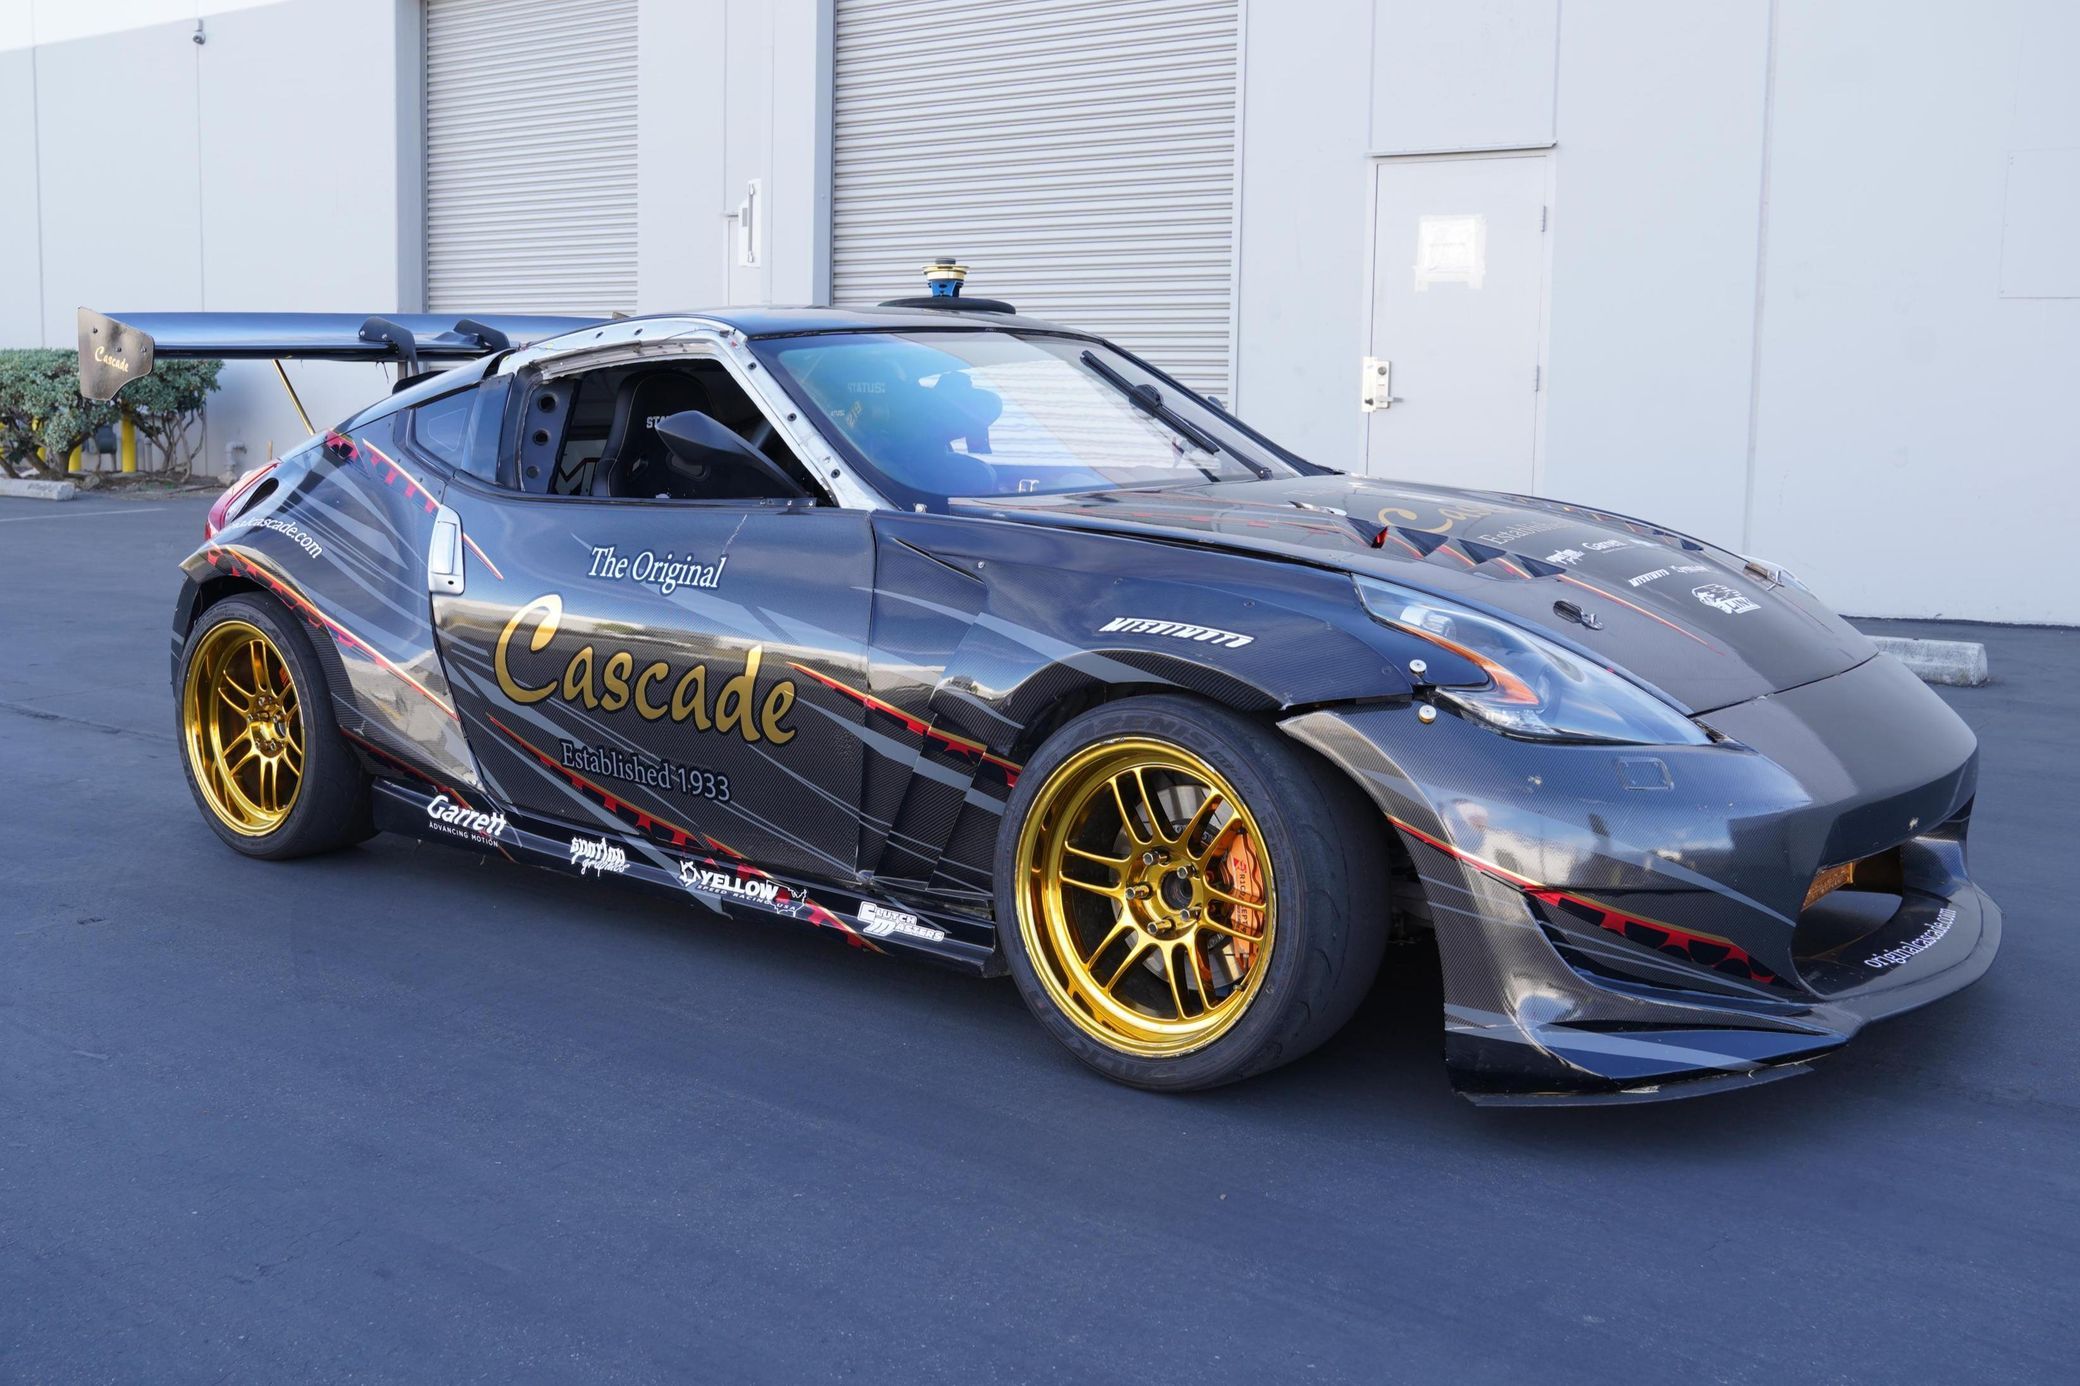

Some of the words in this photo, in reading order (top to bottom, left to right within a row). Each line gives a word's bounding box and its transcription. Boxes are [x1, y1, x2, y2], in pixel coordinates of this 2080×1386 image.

[94, 345, 129, 372] Cascade
[588, 546, 628, 578] The
[632, 551, 727, 594] Original
[494, 593, 797, 745] Cascade
[561, 742, 672, 789] Established
[678, 768, 731, 801] 1933
[427, 794, 507, 836] Garrett
[429, 821, 469, 839] ADVANCING
[471, 834, 499, 847] MOTION
[696, 884, 728, 895] SPEED
[733, 893, 770, 905] RACING
[776, 902, 796, 911] USA
[700, 869, 779, 900] YELLOW
[858, 902, 917, 924] CLUTCH
[864, 917, 944, 941] MASTERS
[1864, 907, 1957, 969] originalcascade.com
